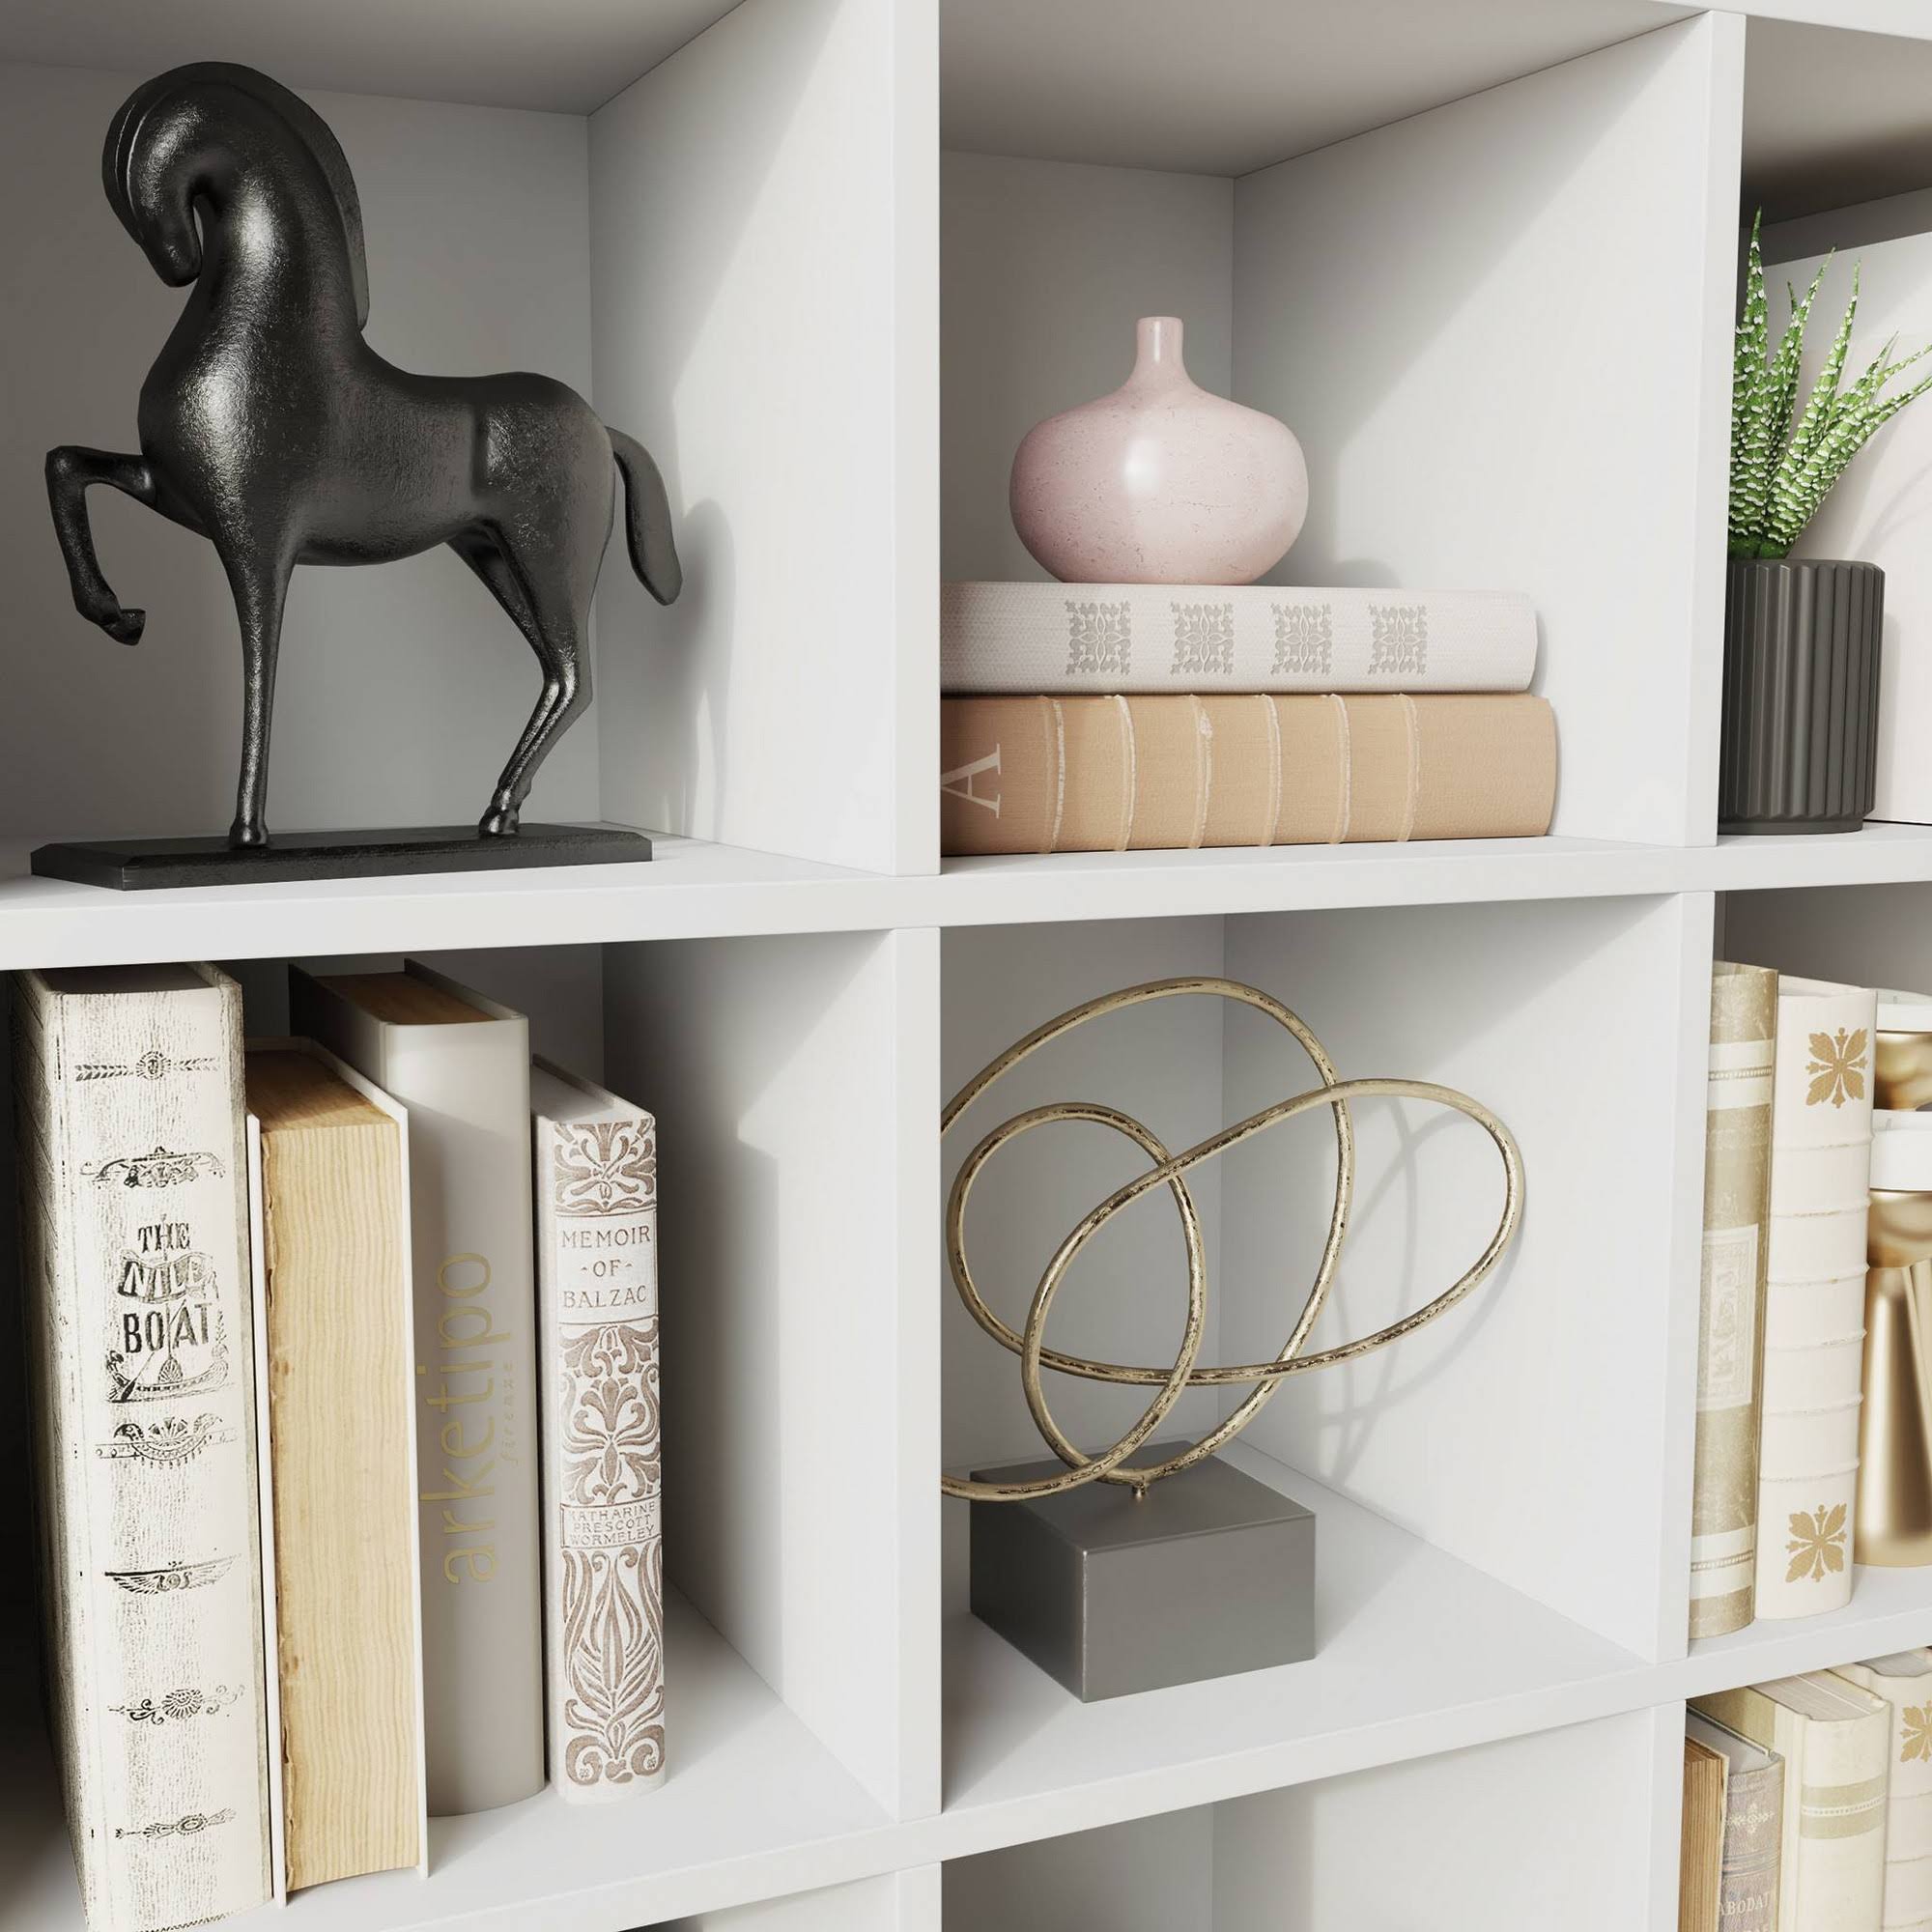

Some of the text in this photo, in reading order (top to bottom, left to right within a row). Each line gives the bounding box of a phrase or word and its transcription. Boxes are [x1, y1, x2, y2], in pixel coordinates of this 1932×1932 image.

[137, 1223, 190, 1253] THE
[561, 1225, 651, 1248] MEMOIR
[563, 1285, 647, 1309] BALZAC
[123, 1302, 210, 1353] BOAT
[415, 1252, 510, 1584] arketipo
[570, 1524, 654, 1546] WORMELEY
[573, 1514, 650, 1534] PRESCOTT
